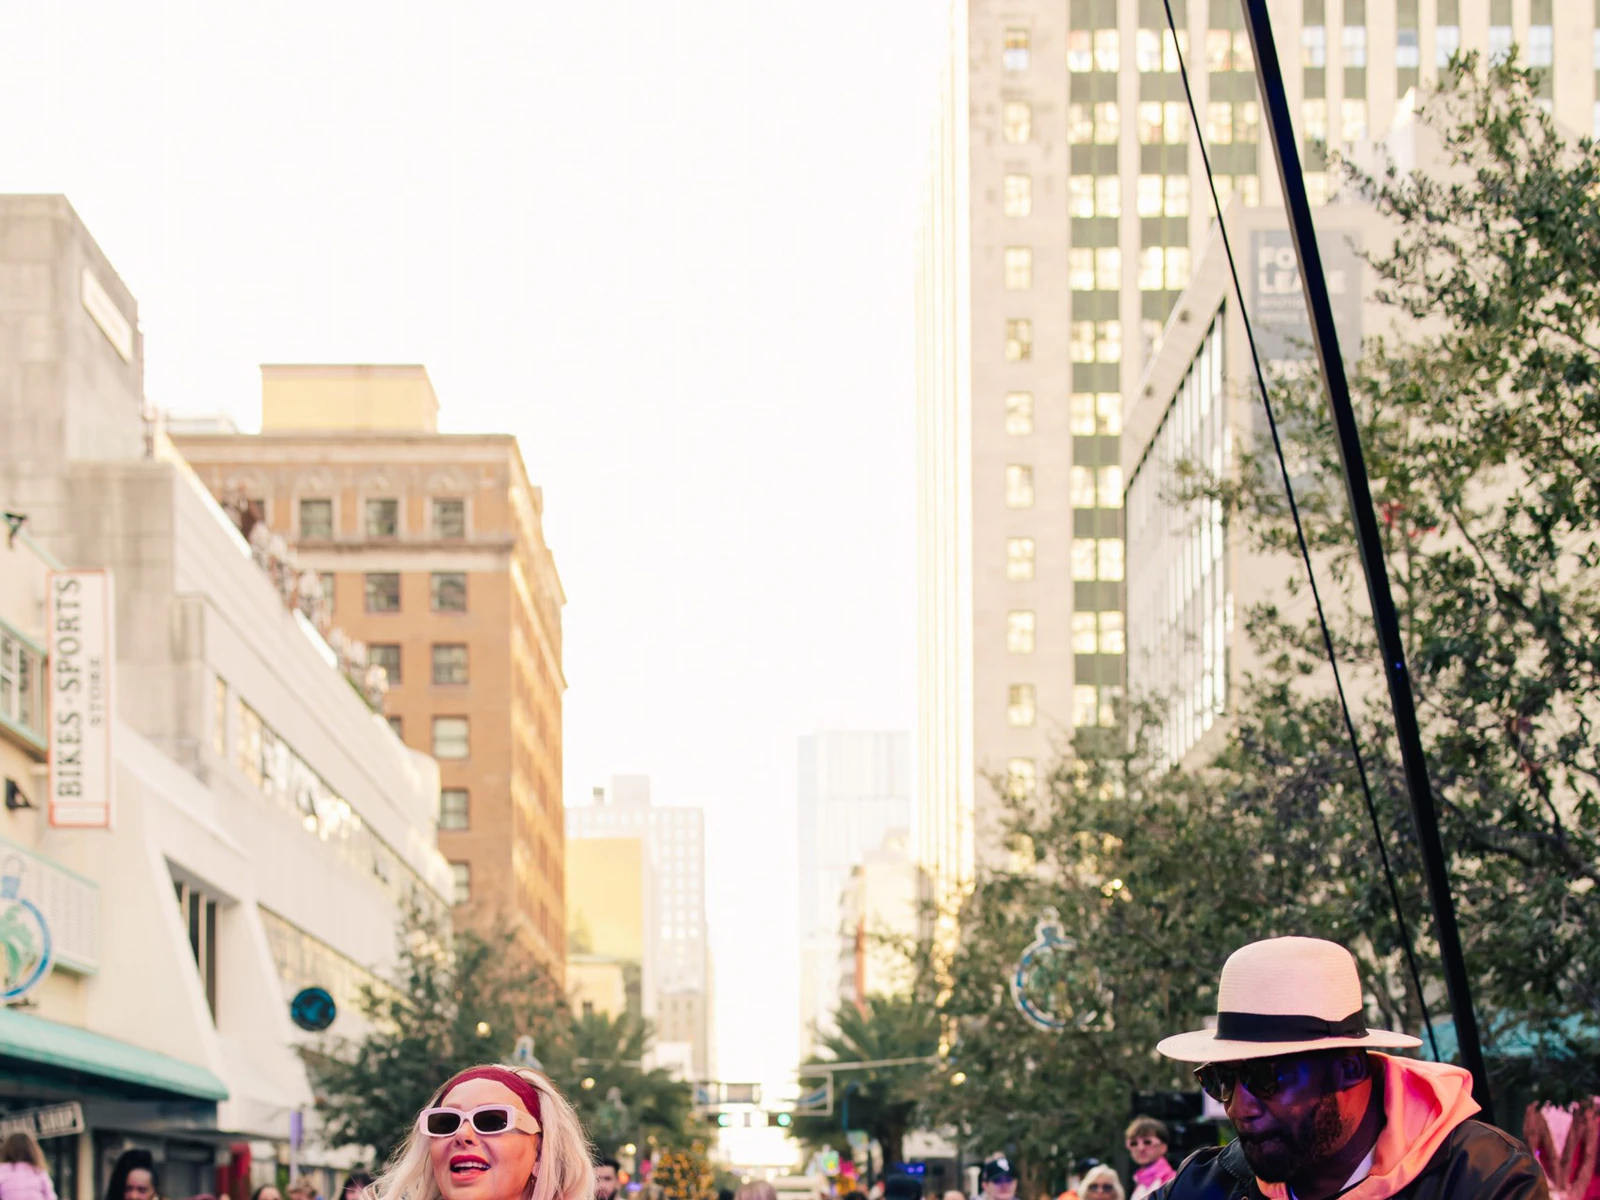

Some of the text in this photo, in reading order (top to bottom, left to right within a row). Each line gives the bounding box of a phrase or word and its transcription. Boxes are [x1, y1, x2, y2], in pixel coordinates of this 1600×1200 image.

[1259, 247, 1299, 269] FO
[55, 579, 82, 798] BIKES SPORTS
